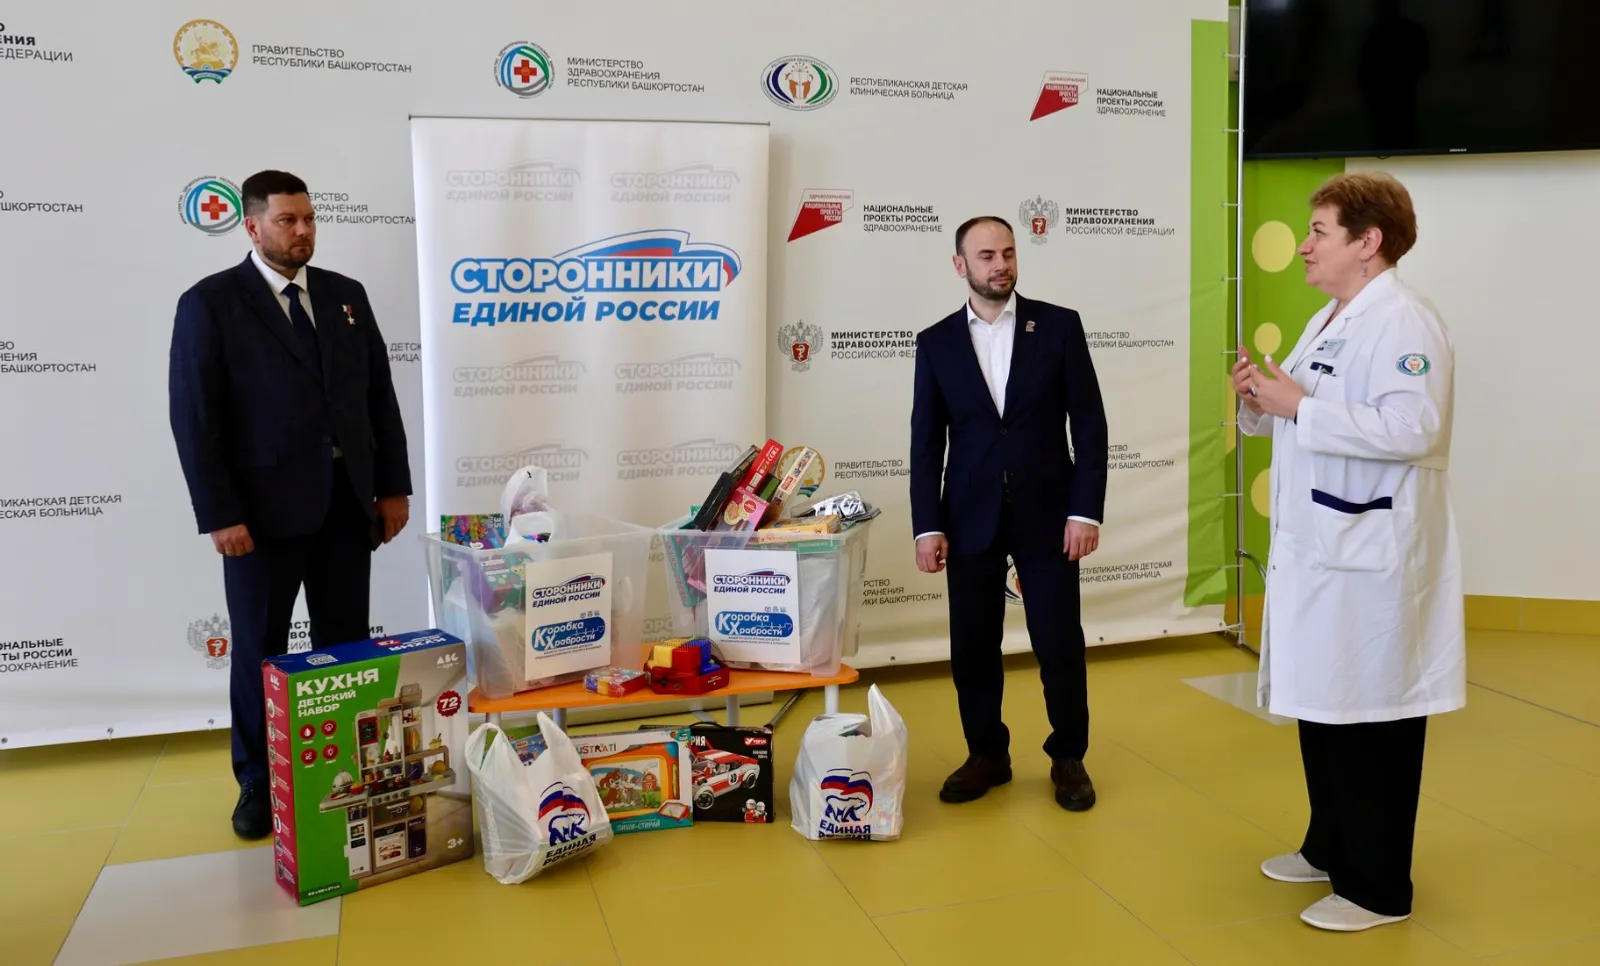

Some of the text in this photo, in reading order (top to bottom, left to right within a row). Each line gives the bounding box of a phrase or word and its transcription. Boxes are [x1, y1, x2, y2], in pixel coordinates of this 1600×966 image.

[0, 47, 73, 62] ЕДЕРАЦИИ
[252, 45, 345, 58] ПРАВИТЕЛЬСТВО
[252, 56, 412, 73] РЕСПУБЛИКИ БАШКОРТОСТАН
[567, 57, 644, 69] МИНИСТЕРСТВО
[567, 68, 661, 80] ЗДРАВООХРАНЕНИЯ
[567, 79, 705, 93] РЕСПУБЛИКИ БАШКОРТОСТАН
[850, 77, 968, 91] РЕСПУБЛИКАНСКАЯ ДЕТСКАЯ
[850, 88, 955, 100] КЛИНИЧЕСКАЯ БОЛЬНИЦА
[1096, 88, 1158, 99] НАЦИОНАЛЬНЫЕ
[1096, 97, 1163, 108] ПРОЕКТЫ РОССИИ
[1096, 106, 1166, 117] ЗДРАВООХРАНЕНИЕ
[446, 170, 573, 187] СТОРОННИКИ
[610, 172, 731, 189] СТОРОННИКИ
[1, 202, 83, 212] ШКОРТОСТАН
[863, 204, 933, 214] НАЦИОНАЛЬНЫЕ
[1065, 207, 1139, 216] МИНИСТЕРСТВО
[863, 214, 939, 223] ПРОЕКТЫ РОССИИ
[1065, 217, 1155, 225] ЗДРАВООХРАНЕНИЯ
[863, 224, 942, 233] ЗДРАВООХРАНЕНИЕ
[1065, 226, 1175, 236] РОССИЙСКОЙ ФЕДЕРАЦИИ
[451, 256, 723, 293] СТОРОННИКИ
[452, 297, 720, 327] ЕДИНОЙ РОССИИ
[831, 331, 913, 340] МИНИСТЕРСТВО
[1084, 331, 1130, 339] ВИТЕЛЬСТВО
[390, 342, 421, 352] ДЕТСК
[831, 340, 918, 349] ЗДРАВООХРАНЕН
[1118, 340, 1174, 348] БАШКОРТОСТАН
[831, 349, 896, 359] РОССИЙСКОЙ
[1, 363, 97, 373] БАШКОРТОСТАН
[453, 364, 578, 383] СТОРОННИКИ
[615, 361, 734, 380] СТОРОННИКИ
[454, 382, 578, 398] ЕДИНОЙ РОССИИ
[615, 378, 733, 393] ЕДИНОЙ РОССИИ
[617, 447, 735, 466] СТОРОННИКИ
[834, 459, 903, 470] ПРАВИТЕЛЬСТВО
[1118, 460, 1174, 469] БАШКОРТОСТАН
[617, 465, 674, 480] ЕДИНОЙ
[834, 470, 888, 479] РЕСПУБЛИКИ
[68, 494, 122, 506] ДЕТСКАЯ
[39, 506, 104, 517] БОЛЬНИЦА
[1079, 561, 1172, 575] СПУБЛИКАНСКАЯ ДЕТСКАЯ
[713, 574, 786, 586] СТОРОННИКИ
[1122, 571, 1161, 580] БОЛЬНИЦА
[532, 580, 601, 599] СТОРОННИКИ
[713, 585, 786, 595] ЕДИНОЙ РОССИИ
[532, 590, 600, 608] ЕДИНОЙ РОССИИ
[879, 593, 942, 605] БАШКОРТОСТАН
[718, 613, 770, 631] Коробка
[728, 621, 782, 636] Храбрости
[534, 621, 584, 649] Коробка
[545, 633, 596, 650] Храбрости
[23, 648, 73, 660] РОССИИ
[295, 668, 380, 697] КУХНЯ
[297, 689, 356, 709] ДЕТСКИЙ
[440, 696, 458, 709] 72
[298, 703, 340, 718] НАБОР
[690, 735, 706, 747] РИЯ
[820, 819, 871, 834] ЕДИНАЯ
[447, 837, 464, 849] 3+
[546, 833, 597, 858] ЕДИНАЯ
